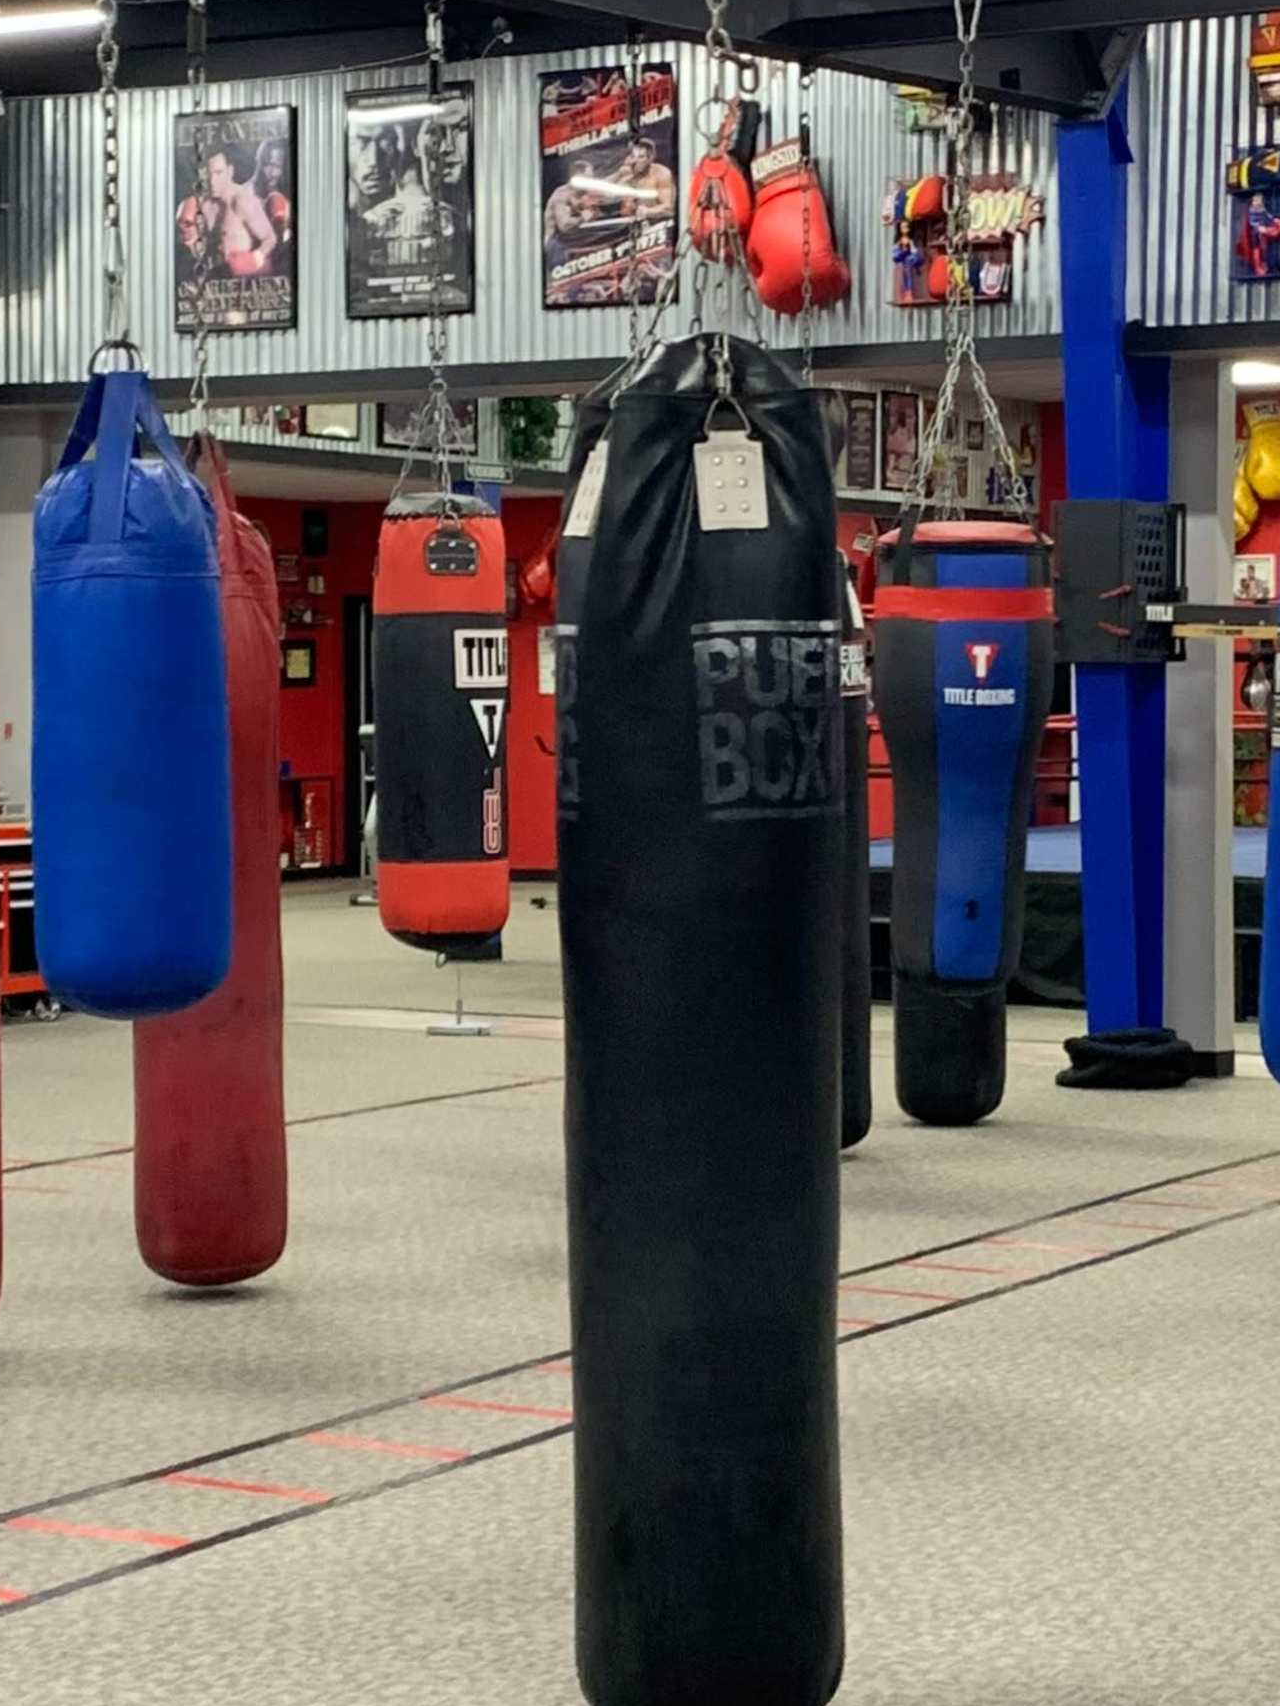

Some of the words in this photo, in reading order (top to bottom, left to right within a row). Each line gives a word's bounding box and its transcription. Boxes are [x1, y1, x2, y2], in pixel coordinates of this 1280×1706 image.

[968, 190, 1025, 231] OW!
[551, 248, 613, 280] OCTOBER
[463, 637, 507, 677] TITL
[943, 687, 975, 706] TITLE
[699, 711, 838, 804] BOX
